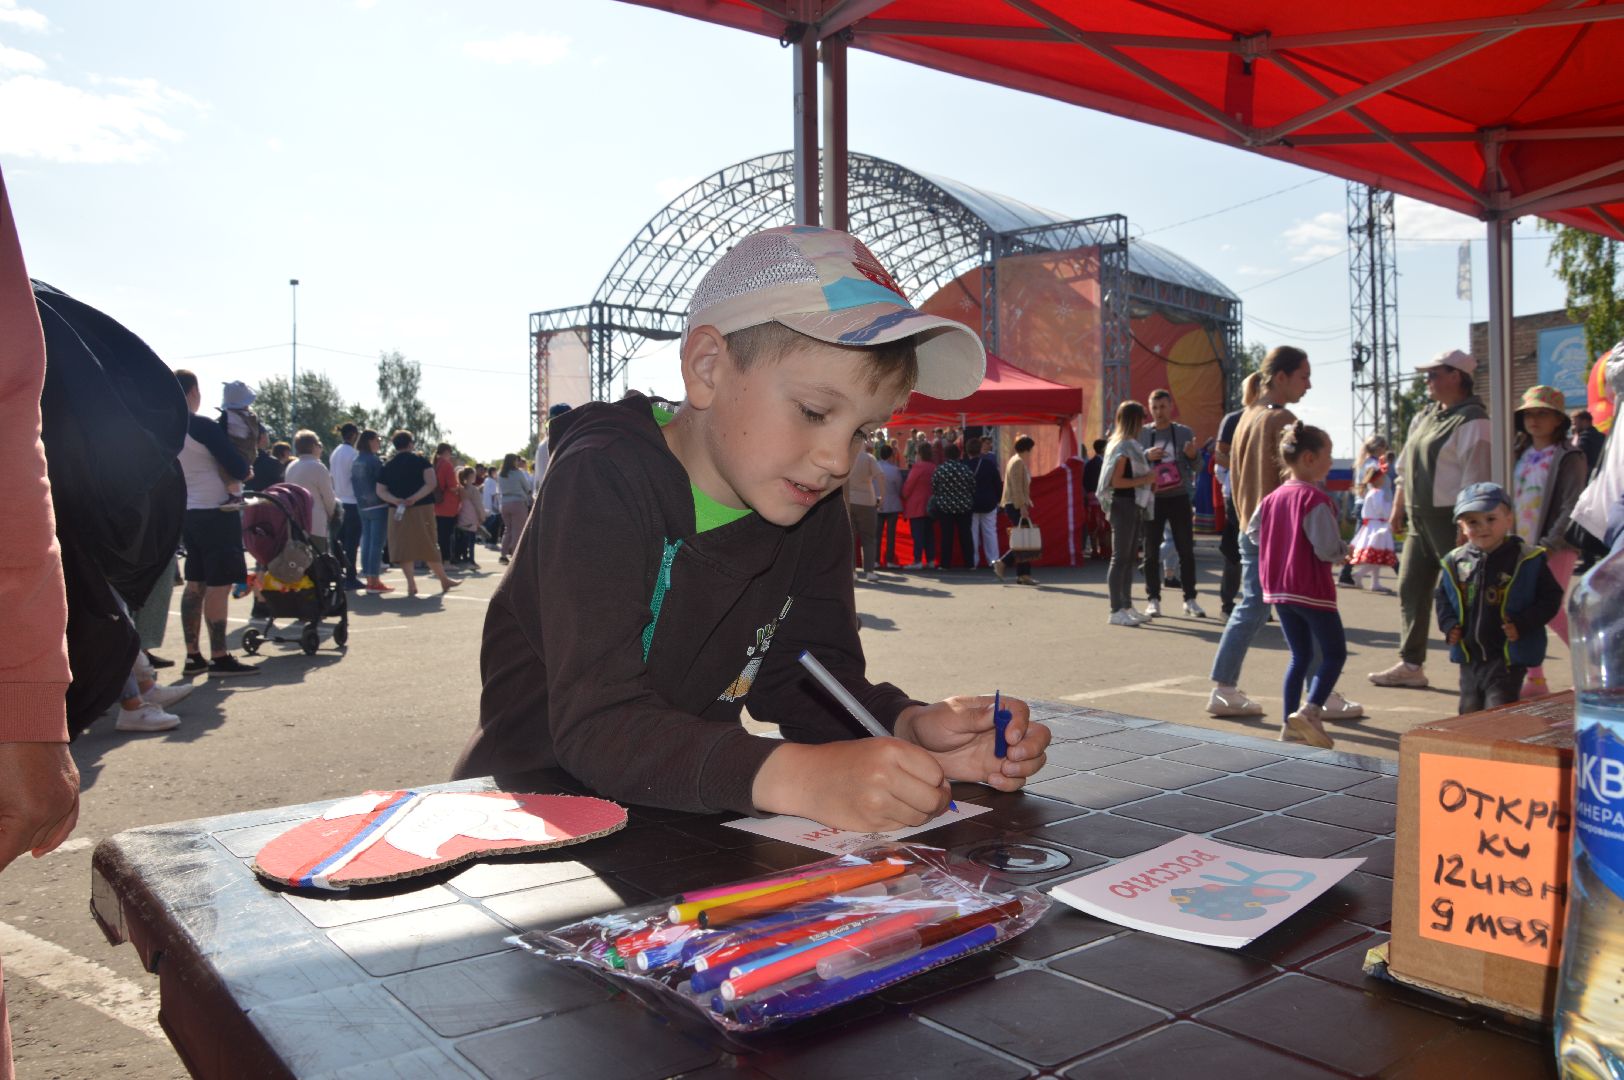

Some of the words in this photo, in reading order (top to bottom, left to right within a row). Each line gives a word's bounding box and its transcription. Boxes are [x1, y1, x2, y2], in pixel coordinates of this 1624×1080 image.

[1108, 849, 1221, 900] РОССИЮ
[1430, 896, 1454, 932] 9
[1465, 912, 1551, 950] мая
